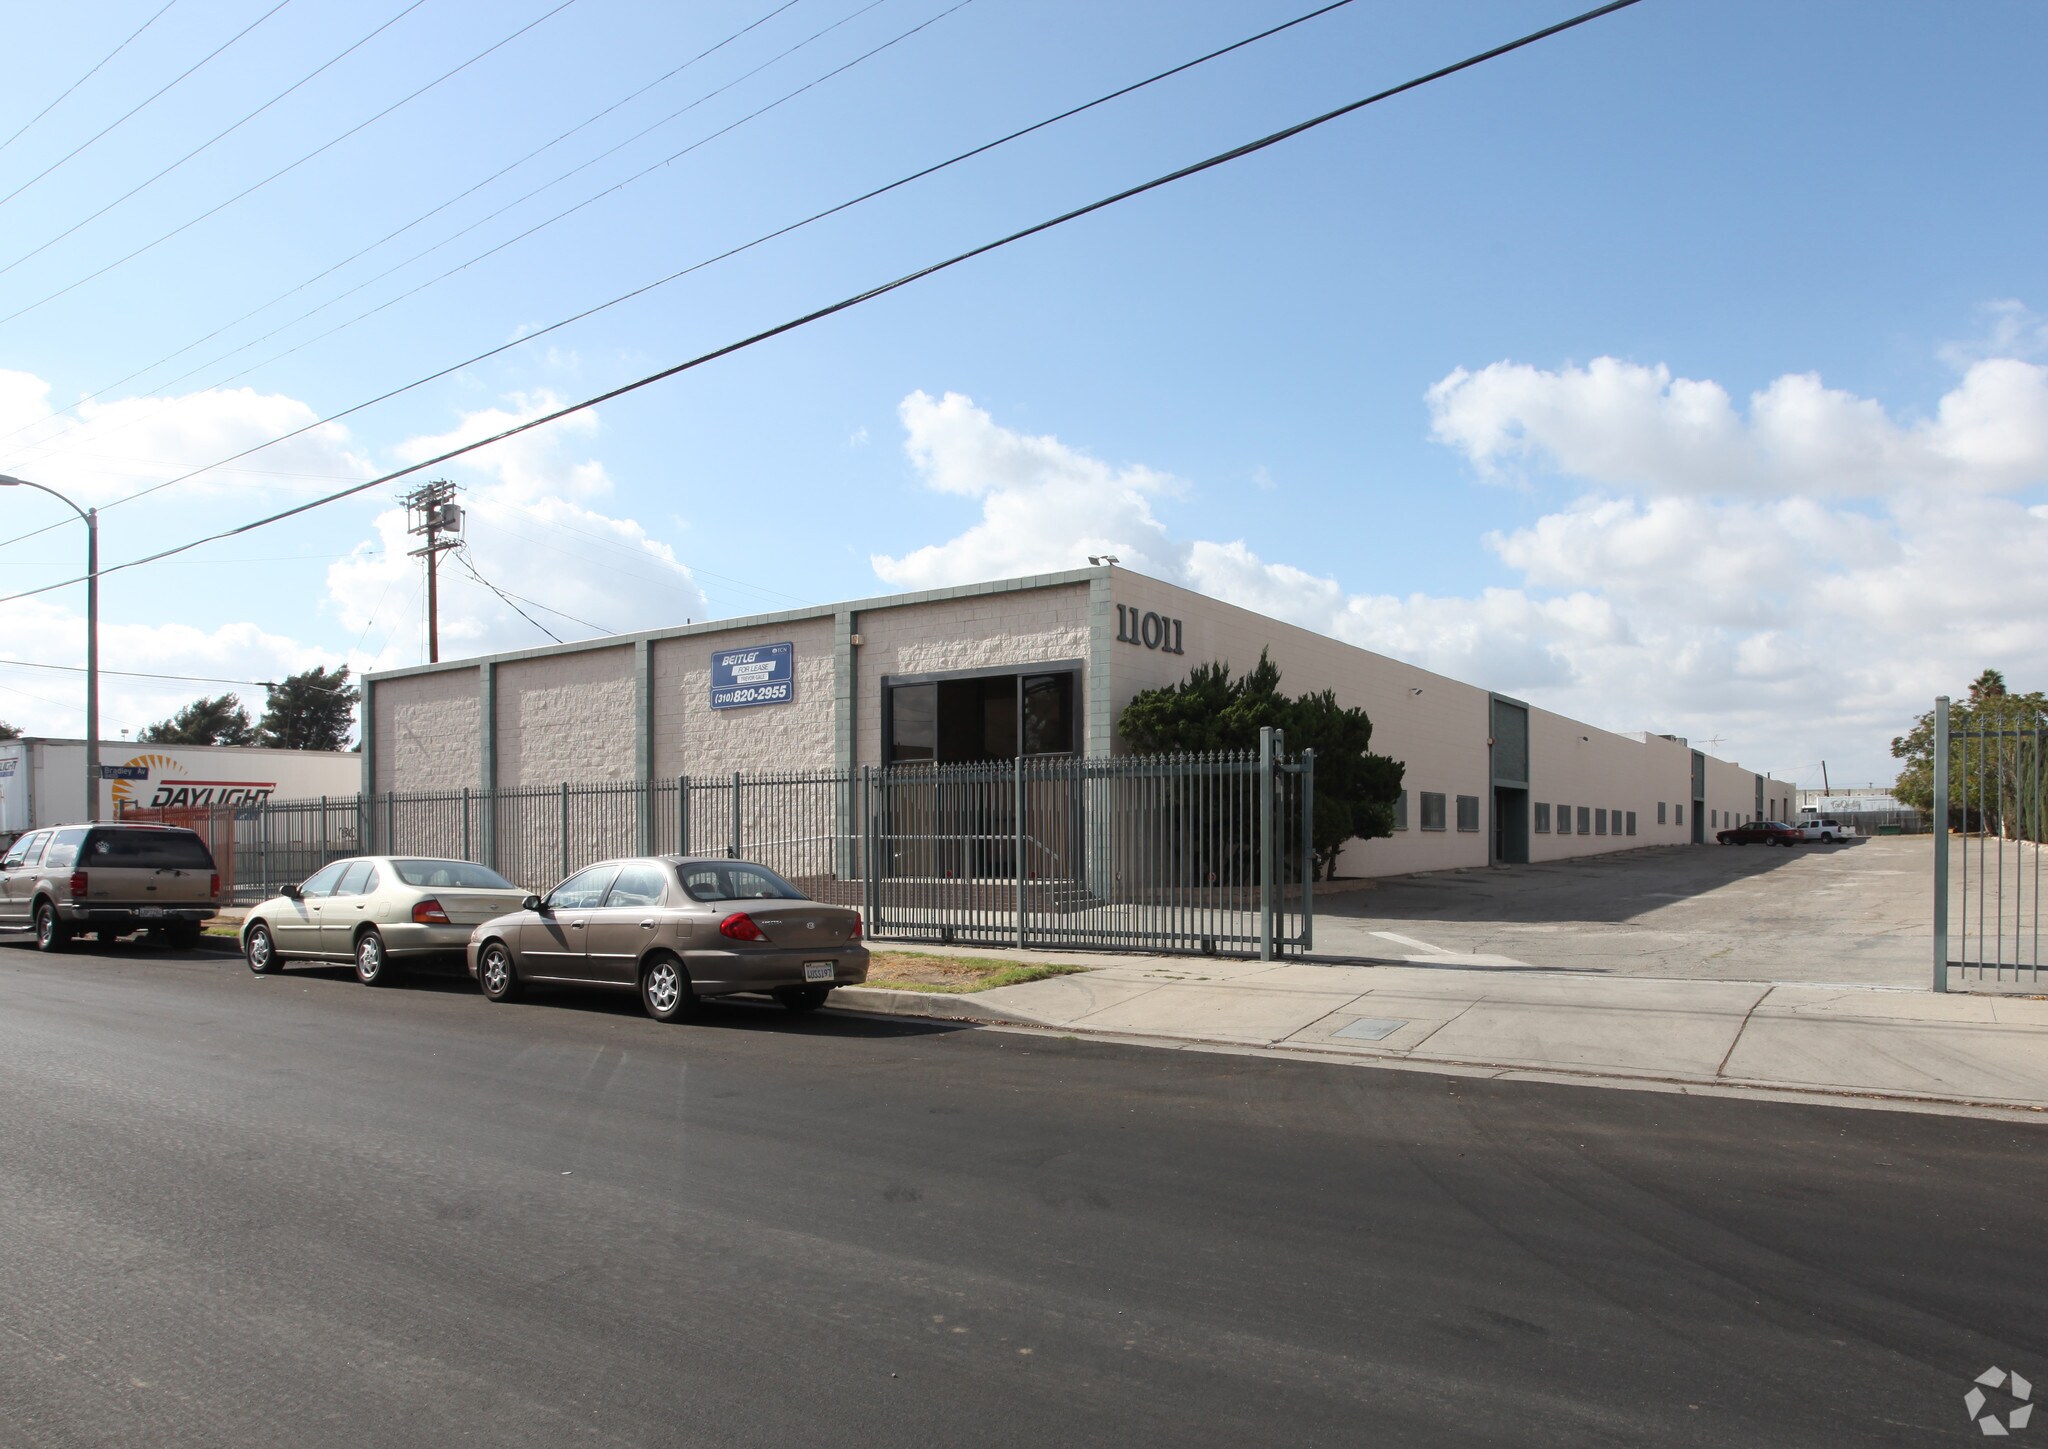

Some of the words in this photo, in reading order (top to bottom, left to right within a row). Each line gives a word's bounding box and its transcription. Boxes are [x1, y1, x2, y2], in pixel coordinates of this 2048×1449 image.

[1117, 603, 1184, 655] 11011
[738, 666, 750, 674] FOR
[750, 663, 769, 672] LEASE
[104, 766, 132, 776] Bradley
[137, 766, 146, 775] Av
[151, 787, 276, 808] DAYLIGHT
